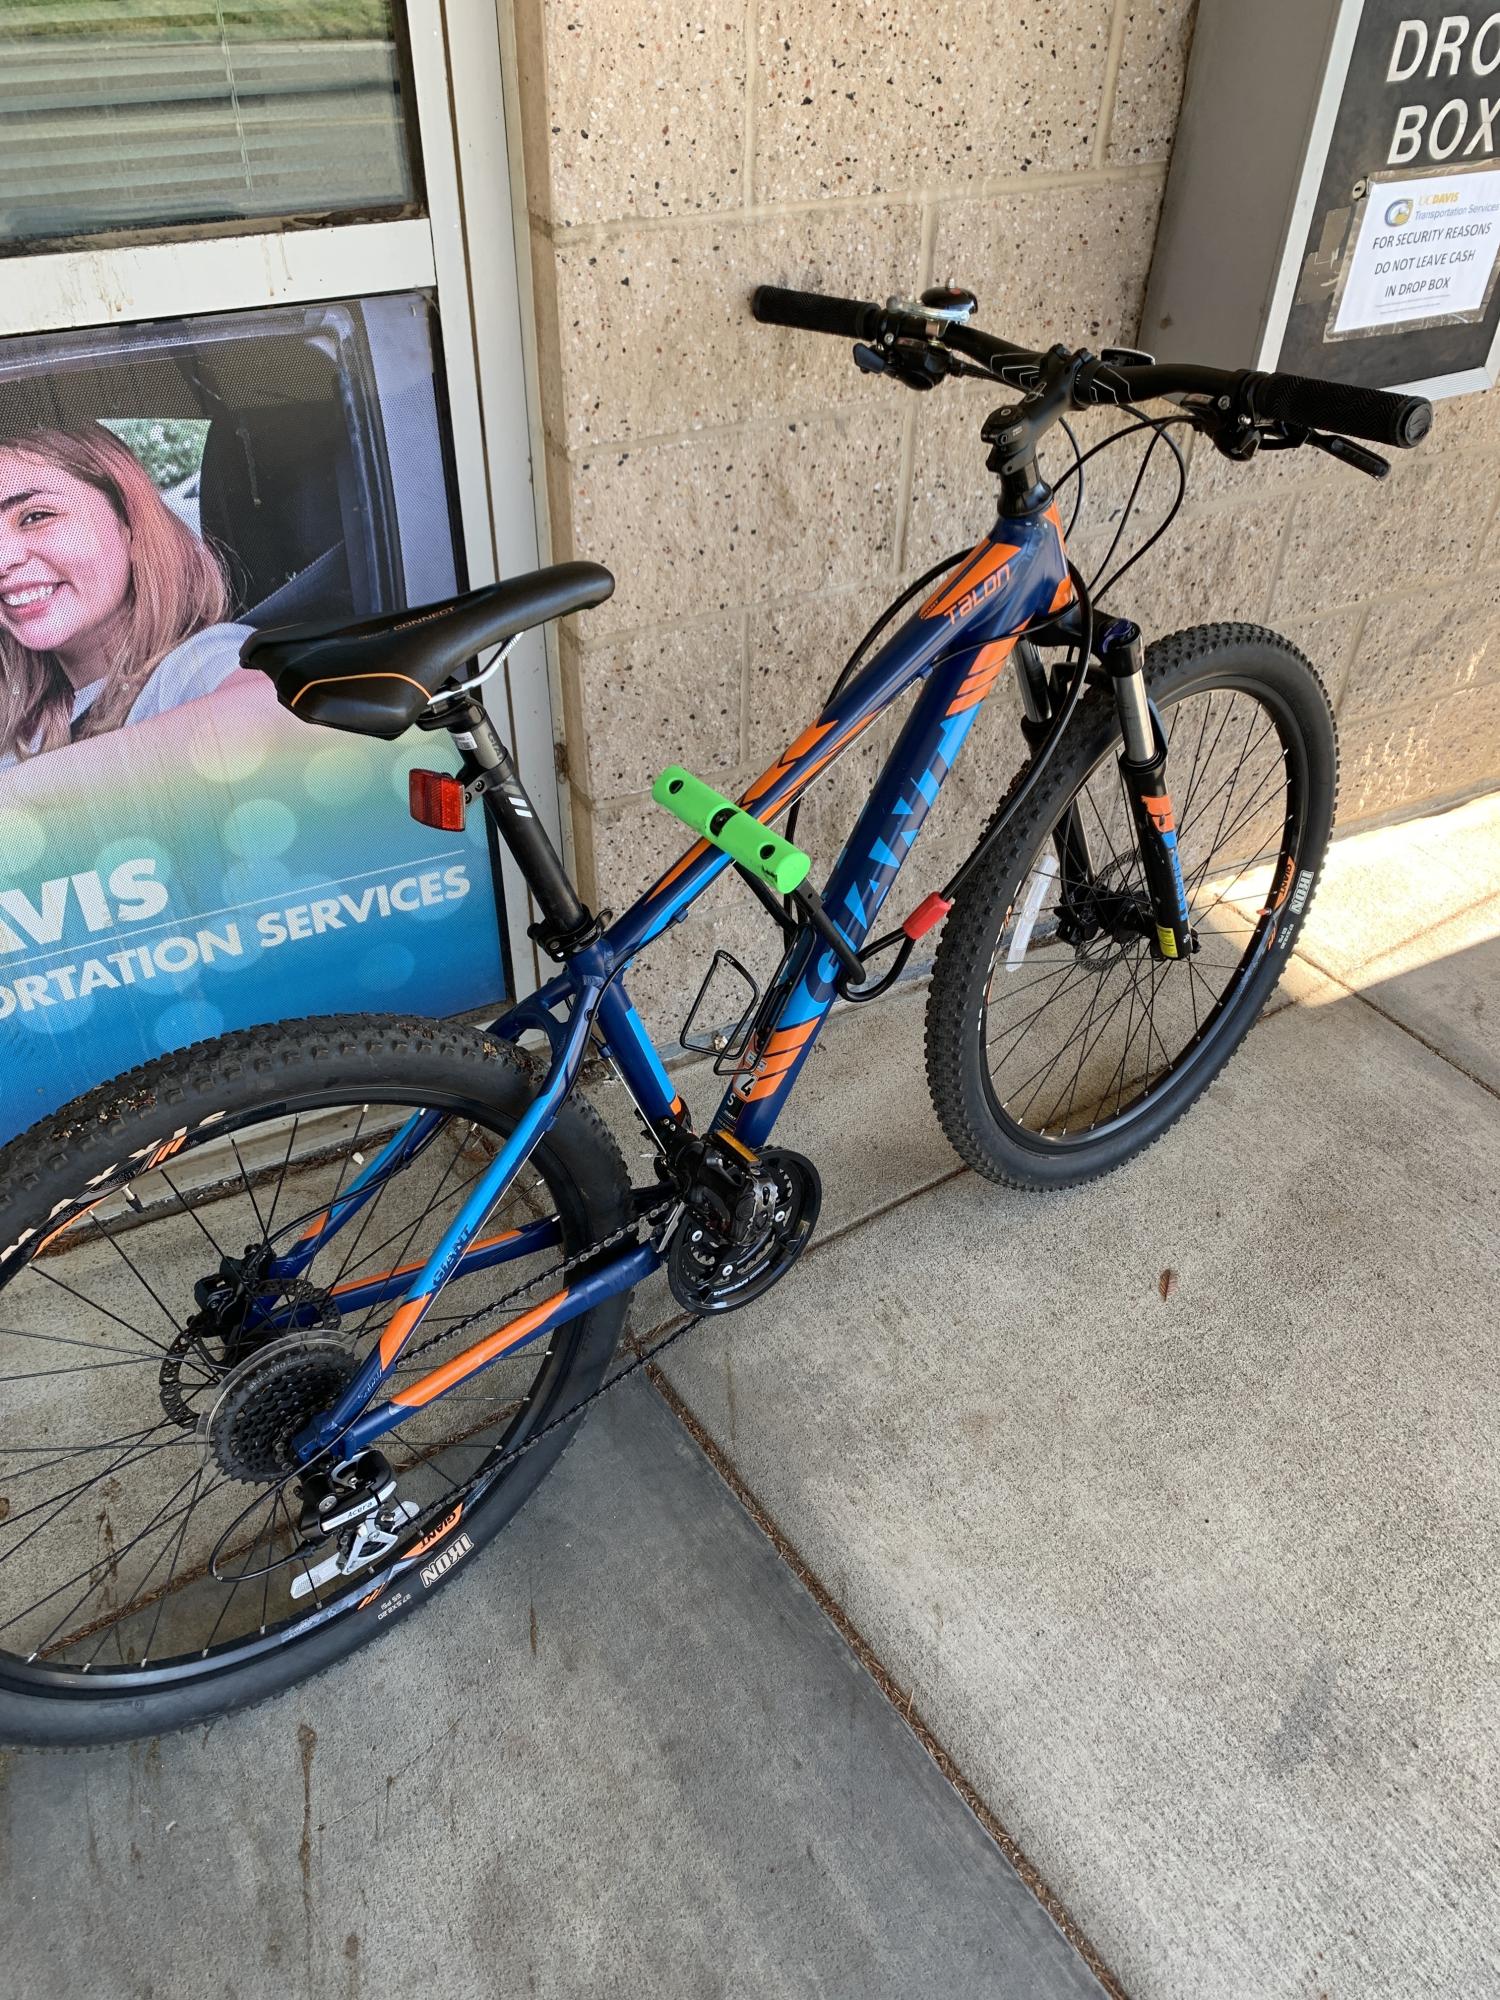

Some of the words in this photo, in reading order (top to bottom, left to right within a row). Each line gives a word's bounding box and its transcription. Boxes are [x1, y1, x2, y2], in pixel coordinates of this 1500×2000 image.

[1387, 98, 1500, 165] BOX
[1432, 191, 1460, 205] DAVIS
[1415, 206, 1467, 221] Transportation
[1468, 202, 1500, 214] Services
[1372, 236, 1394, 250] FOR
[1395, 228, 1445, 247] SECURITY
[1445, 222, 1493, 240] REASONS
[1375, 262, 1391, 275] DO
[1392, 257, 1415, 272] NOT
[1416, 253, 1448, 269] LEAVE
[1449, 249, 1476, 265] CASH
[1385, 285, 1396, 298] IN
[1398, 280, 1427, 296] DROP
[1428, 277, 1451, 291] BOX
[393, 606, 456, 632] CONNECT
[1280, 863, 1292, 897] GIANT
[1289, 869, 1315, 915] IKON
[256, 864, 471, 948] SERVICES
[727, 1093, 736, 1106] S
[741, 1078, 755, 1097] 4
[347, 1501, 374, 1520] Acera
[420, 1512, 456, 1549] GIANT
[420, 1533, 475, 1588] IKON
